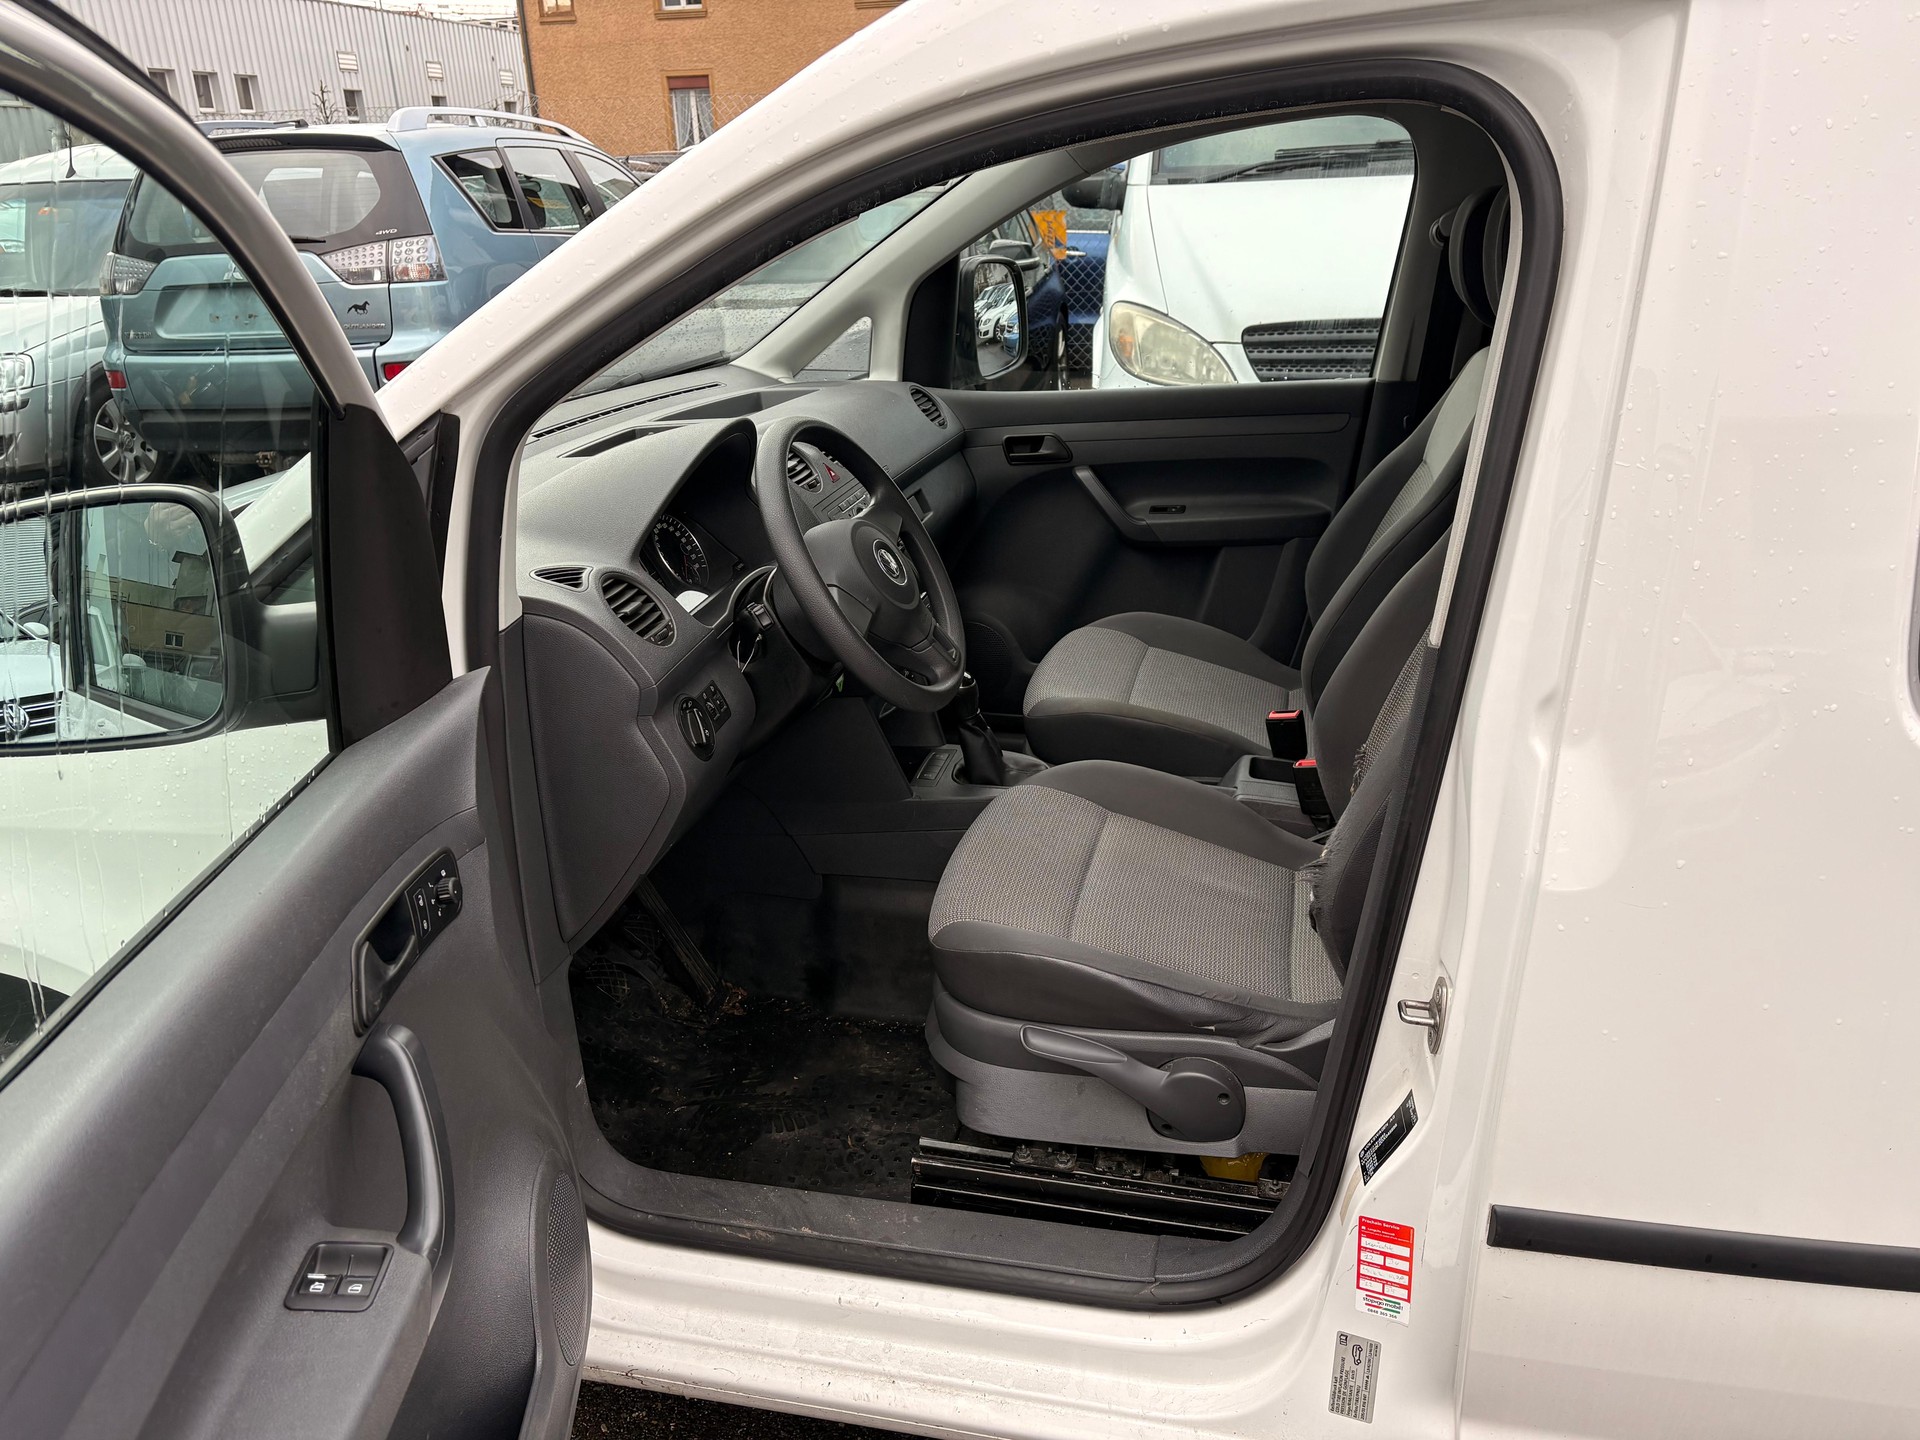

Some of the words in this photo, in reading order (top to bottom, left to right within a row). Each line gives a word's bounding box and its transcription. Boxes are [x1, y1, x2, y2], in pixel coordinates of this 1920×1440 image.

[375, 228, 398, 236] 4WD
[1361, 1218, 1382, 1226] Prochain
[1383, 1222, 1400, 1230] Service
